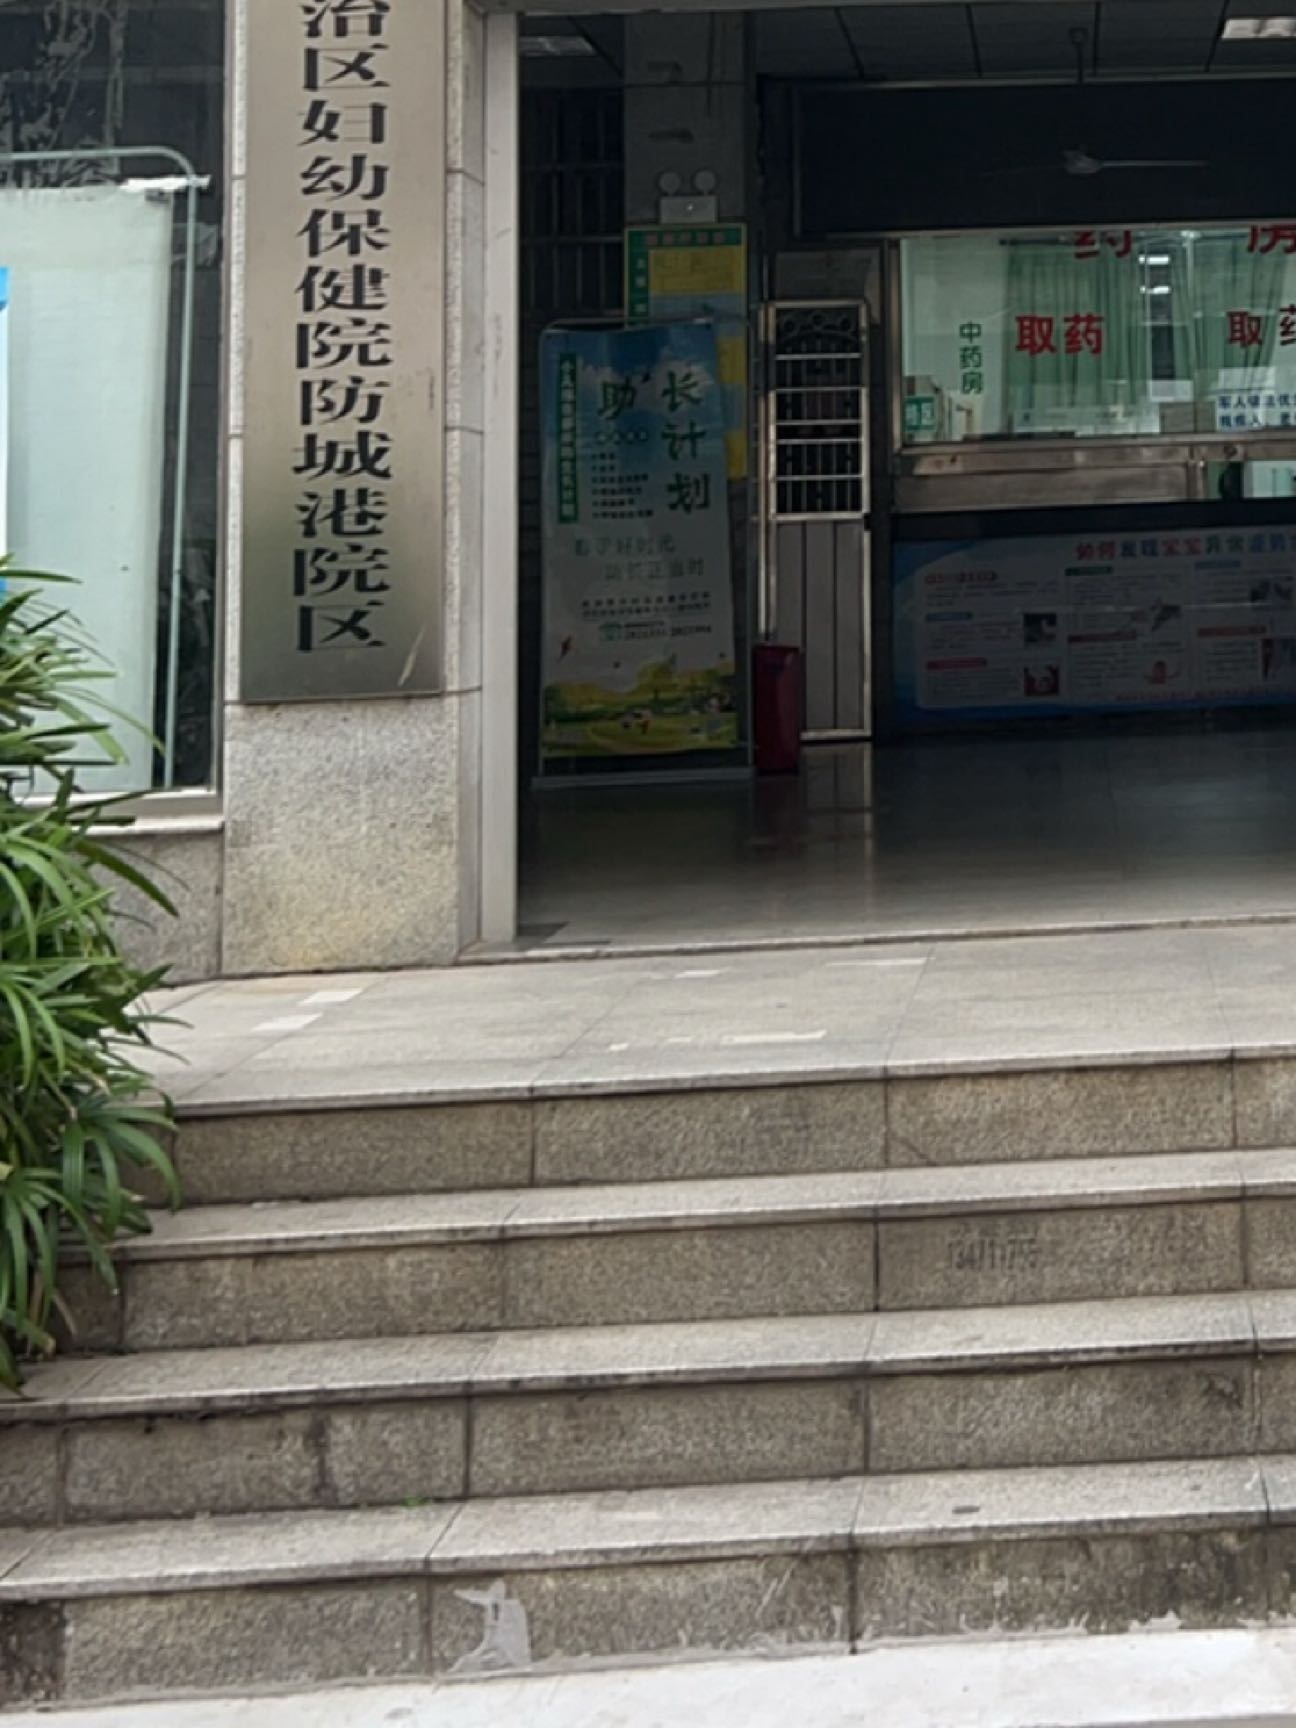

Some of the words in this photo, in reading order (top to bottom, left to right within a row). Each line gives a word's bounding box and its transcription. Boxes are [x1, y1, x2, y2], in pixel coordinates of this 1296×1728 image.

[959, 321, 983, 395] 中药房
[1015, 313, 1105, 356] 取药
